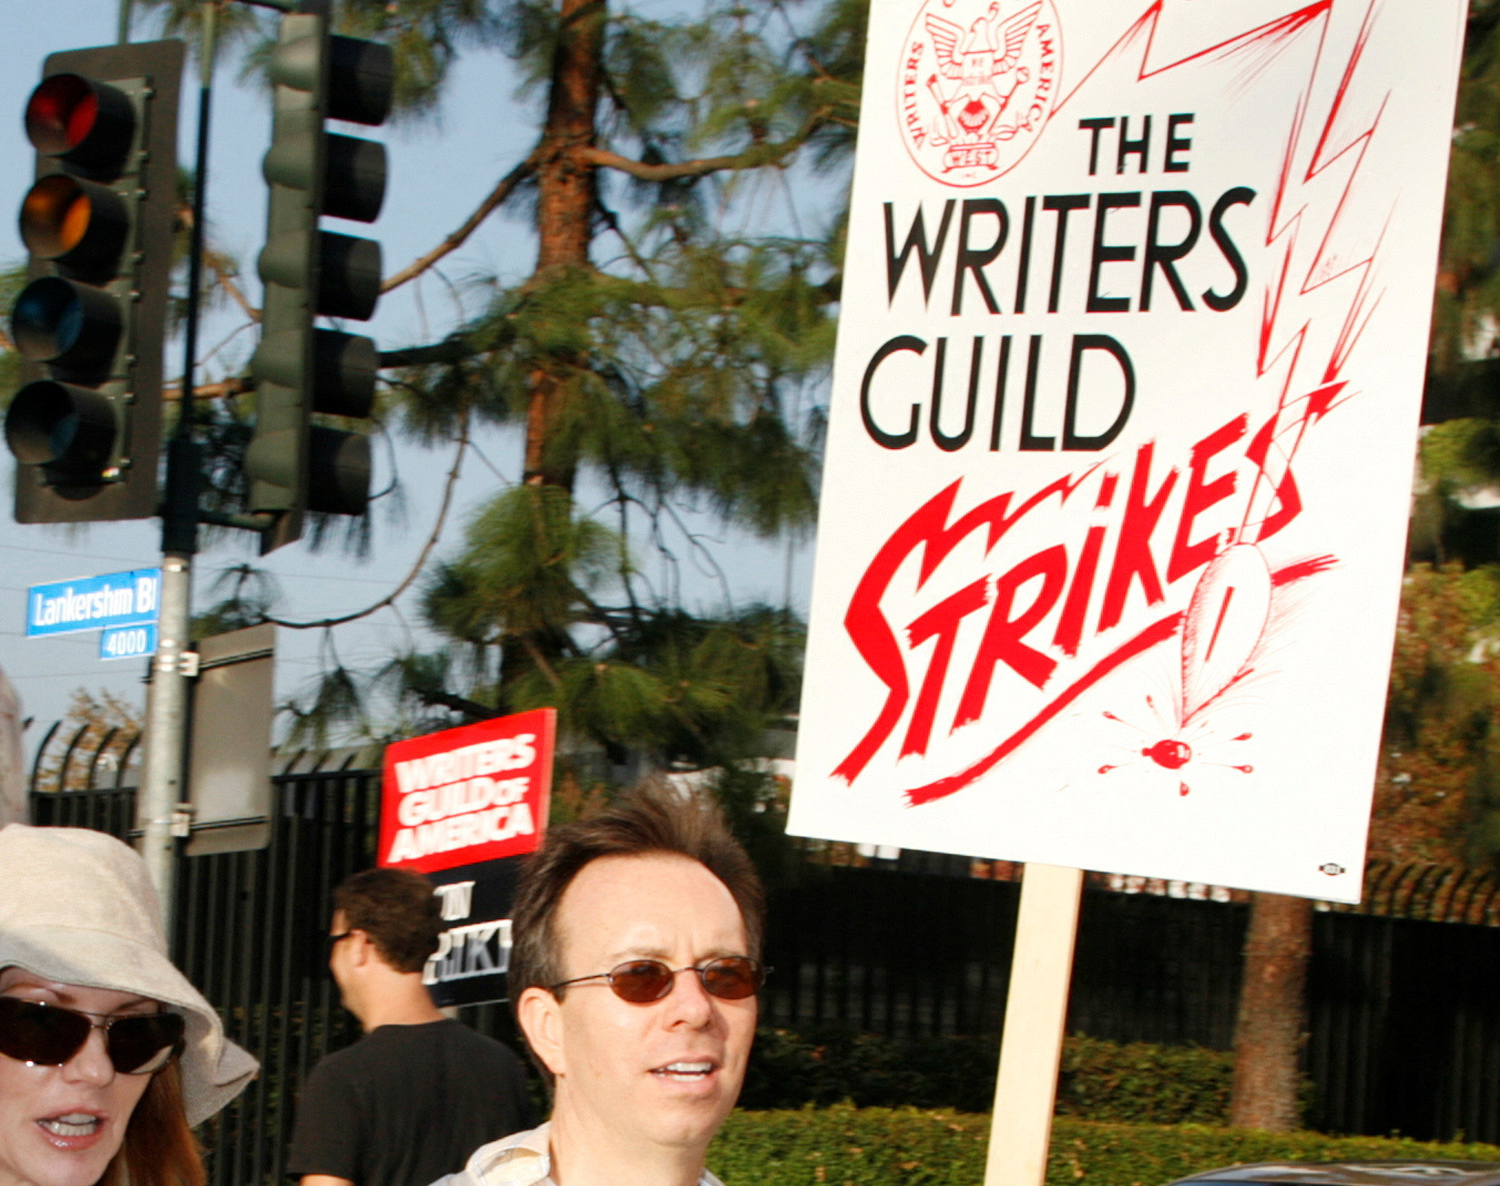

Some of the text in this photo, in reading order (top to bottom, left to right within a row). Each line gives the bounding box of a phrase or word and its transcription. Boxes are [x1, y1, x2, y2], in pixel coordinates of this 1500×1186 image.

[1079, 113, 1195, 176] THE
[883, 187, 1258, 316] WRITERS
[860, 334, 1137, 453] GUILD
[107, 629, 147, 656] 4000
[395, 733, 537, 793] WRITERS
[398, 776, 531, 827] GUILD OF
[386, 802, 536, 864] AMERICA
